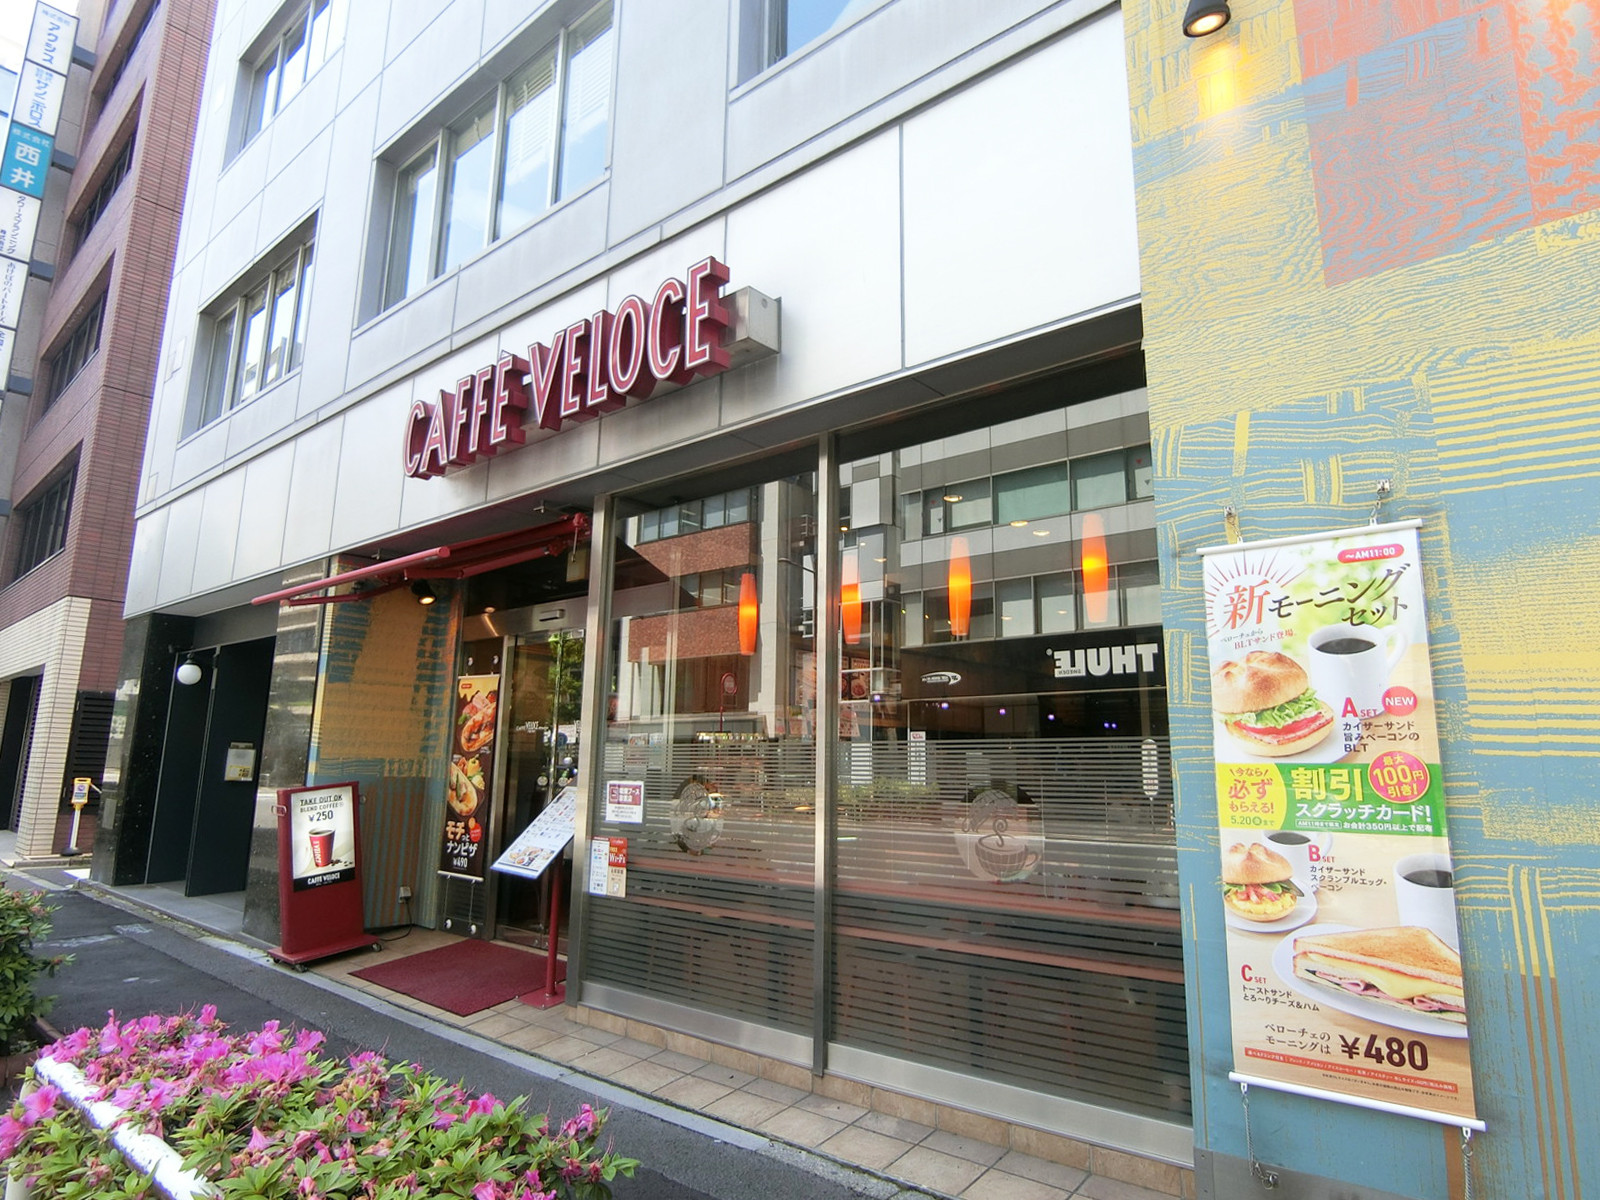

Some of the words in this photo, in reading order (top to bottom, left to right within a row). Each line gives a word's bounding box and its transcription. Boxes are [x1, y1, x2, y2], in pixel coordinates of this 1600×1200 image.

[10, 142, 42, 188] 西井
[528, 256, 731, 431] VELOCE
[1342, 597, 1408, 627] セット
[1341, 697, 1358, 718] A
[1360, 709, 1378, 719] SET
[1385, 697, 1414, 706] NEW
[1343, 721, 1414, 732] カイザーサンド
[1343, 732, 1420, 743] 旨みベーコンの
[1344, 743, 1369, 753] BLT
[1383, 754, 1405, 766] 最大
[1291, 767, 1364, 802] 割引
[1373, 764, 1425, 787] 100円
[1228, 777, 1273, 800] 必ず
[300, 796, 318, 806] TAKE
[319, 794, 333, 804] OUT
[333, 793, 343, 802] OK
[300, 805, 318, 813] BLEND
[319, 802, 338, 811] COFFEE
[446, 840, 478, 857] ナンピザ
[1308, 845, 1321, 863] B
[1322, 856, 1335, 864] SET
[1310, 865, 1366, 877] カイザーサンド
[1311, 884, 1343, 893] ベーコン
[1241, 964, 1253, 983] C
[1254, 976, 1267, 985] SET
[1242, 985, 1293, 999] トーストサンド
[1265, 1022, 1331, 1042] ベローチェの
[1265, 1034, 1332, 1056] モーニングは
